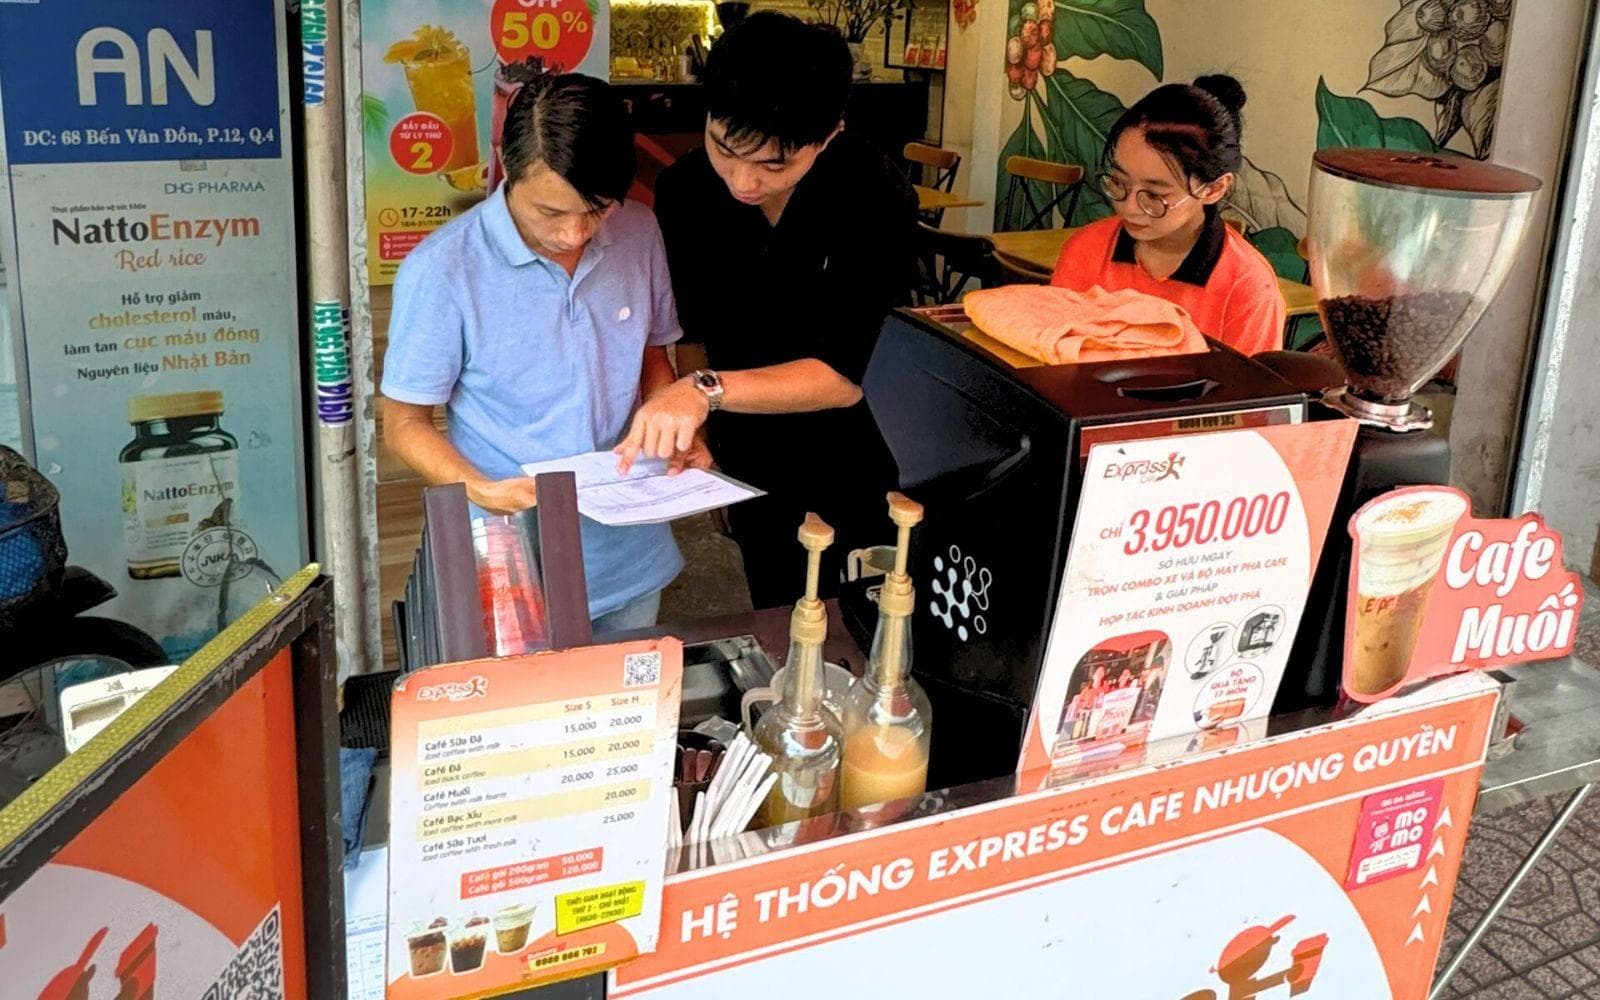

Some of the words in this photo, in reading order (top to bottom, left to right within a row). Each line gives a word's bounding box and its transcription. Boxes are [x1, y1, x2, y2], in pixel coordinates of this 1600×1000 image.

[501, 11, 588, 49] 50%
[75, 27, 216, 106] AN
[24, 130, 57, 146] ĐC:
[61, 129, 82, 144] 68
[86, 126, 121, 145] Bến
[126, 128, 160, 144] Vân
[164, 125, 203, 146] Đồn,
[207, 127, 245, 145] P.12,
[249, 127, 275, 144] Q.4
[413, 132, 423, 140] LY
[411, 142, 433, 169] 2
[164, 183, 194, 195] DHG
[198, 181, 266, 194] PHARMA
[401, 205, 451, 218] 17-22h
[52, 213, 260, 247] NattoEnzym
[115, 249, 163, 272] Red
[168, 251, 208, 267] rice
[121, 292, 141, 306] Hỗ
[145, 293, 164, 307] trợ
[168, 288, 202, 304] giảm
[88, 306, 197, 330] cholesterol
[202, 310, 237, 323] máu,
[64, 343, 91, 356] làm
[95, 341, 118, 353] tan
[123, 334, 158, 353] cục
[165, 330, 207, 347] máu
[77, 364, 129, 380] Nguyên
[134, 360, 159, 375] liệu
[162, 353, 208, 373] Nhật
[214, 348, 251, 367] Bản
[1100, 522, 1123, 540] CHỈ
[1123, 491, 1291, 555] 3.950.000
[1201, 551, 1233, 564] NGAY
[1446, 521, 1555, 598] Cafe
[1087, 583, 1119, 598] TRỌN
[1121, 577, 1162, 592] COMBO
[1164, 573, 1179, 585] XE
[1198, 566, 1213, 581] BỘ
[1215, 561, 1239, 576] MÁY
[1264, 556, 1289, 568] CAFE
[1155, 591, 1163, 601] &
[1190, 582, 1219, 595] PHÁP
[1126, 608, 1145, 621] TÁC
[1147, 604, 1175, 617] KINH
[1177, 598, 1216, 613] DOANH
[1240, 589, 1261, 601] PHÁ
[1451, 582, 1578, 663] Muối
[564, 702, 583, 713] Size
[585, 700, 592, 710] S
[610, 697, 629, 706] Size
[425, 740, 447, 751] Café
[424, 766, 446, 777] Café
[424, 792, 446, 802] Café
[423, 817, 445, 827] Café
[680, 893, 740, 942] HỆ
[754, 861, 915, 923] THỐNG
[927, 815, 1089, 880] EXPRESS
[1100, 791, 1184, 836] CAFE
[1194, 754, 1344, 813] NHƯỢNG
[1353, 725, 1456, 772] QUYỀN
[423, 843, 444, 853] Café
